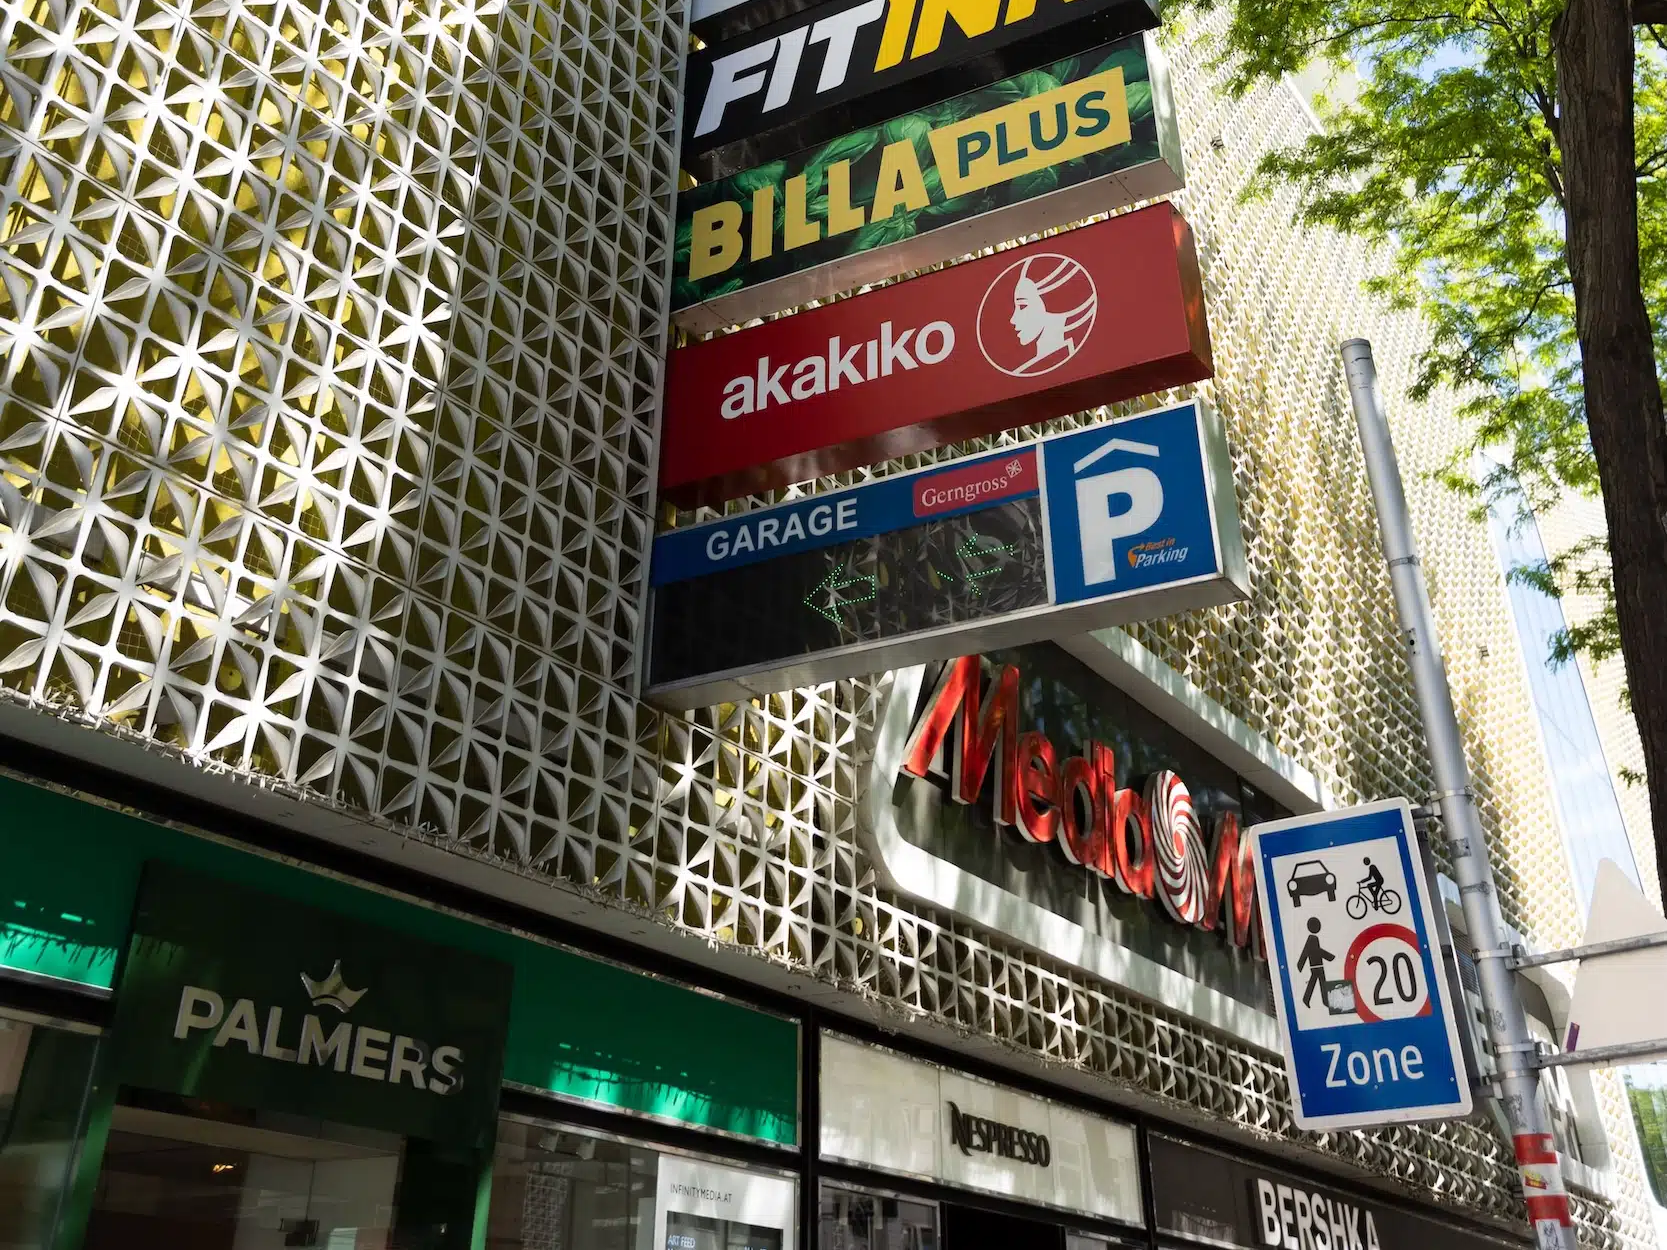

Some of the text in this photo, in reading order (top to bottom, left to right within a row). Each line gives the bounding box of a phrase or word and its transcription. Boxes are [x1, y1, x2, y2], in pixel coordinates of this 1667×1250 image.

[688, 90, 1112, 283] BILLA PLUS
[921, 476, 1008, 507] Gerngross
[706, 498, 858, 562] GARAGE
[1135, 546, 1189, 569] Parking
[1366, 951, 1418, 1006] 20
[173, 985, 465, 1096] PALMERS
[1320, 1043, 1425, 1088] Zone
[946, 1100, 1051, 1167] NESPRESSO
[670, 1183, 733, 1204] INFINITYMEDIA.AT
[1257, 1178, 1382, 1250] BERSHKA
[667, 1235, 696, 1248] ART FEED
